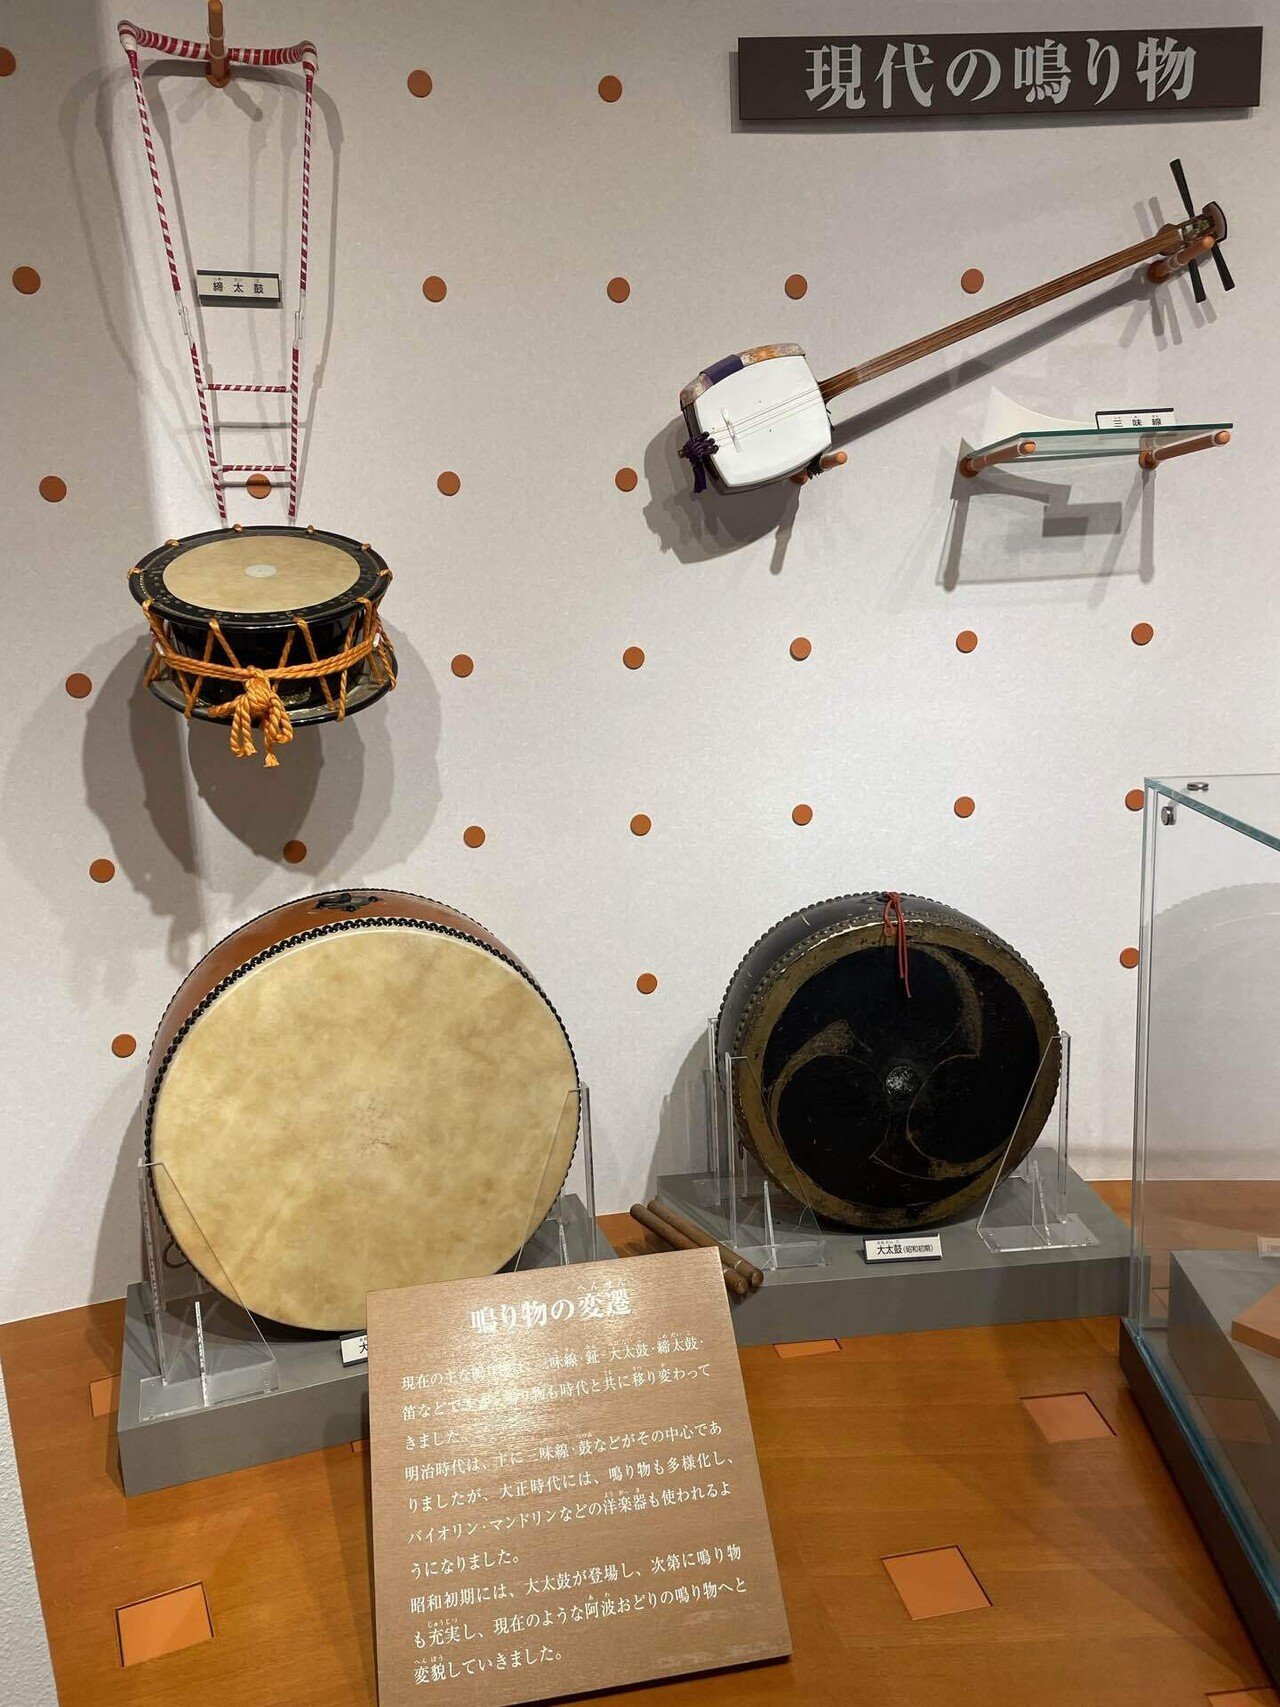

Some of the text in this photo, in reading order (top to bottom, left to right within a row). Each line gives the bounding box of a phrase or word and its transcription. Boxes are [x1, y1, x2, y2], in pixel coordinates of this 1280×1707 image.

[805, 37, 1197, 111] 現代の鳴り物
[1113, 418, 1162, 428] 三味線
[470, 1288, 632, 1334] 鳴り物の変遷
[410, 1549, 520, 1580] うになりました。
[410, 1544, 741, 1614] 昭和初期には、大太鼓が登場し、次第に鳴り物
[415, 1578, 747, 1648] も充実し、現在のような阿波おどりの鳴り物へと
[414, 1645, 562, 1685] 変貌していきました。
